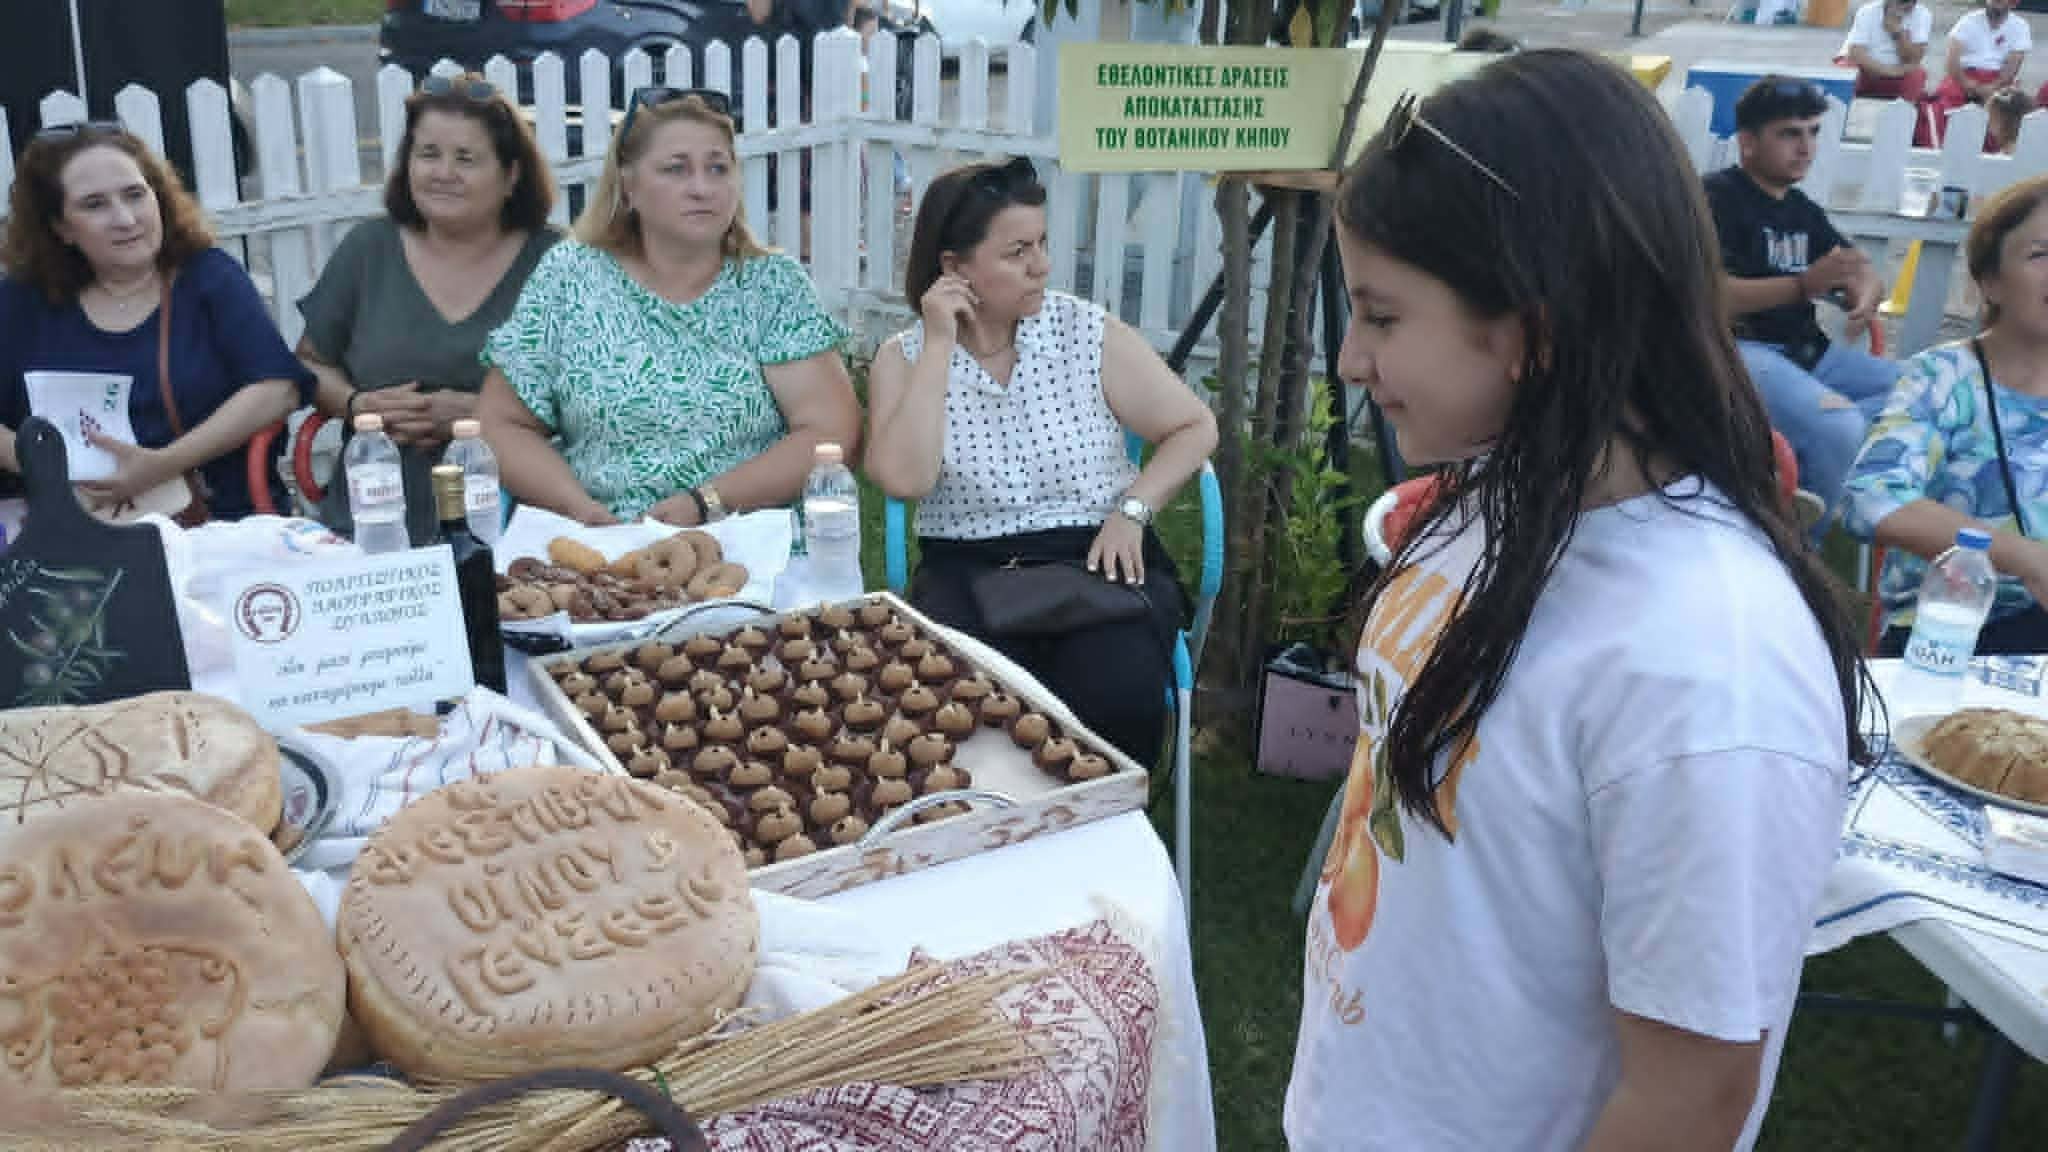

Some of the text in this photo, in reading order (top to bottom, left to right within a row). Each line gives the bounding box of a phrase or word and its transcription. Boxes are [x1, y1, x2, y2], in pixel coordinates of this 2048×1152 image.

[1097, 64, 1290, 88] ΕΘΕΛΟΝΤΙΚΕΣ ΔΡΑΣΕΙΣ
[1123, 95, 1265, 119] ΑΠΟΚΑΤΑΣΤΑΣΗΣ
[1095, 127, 1291, 149] ΤΟΥ ΒΟΤΑΝΙΚΟΥ ΚΗΠΟΥ
